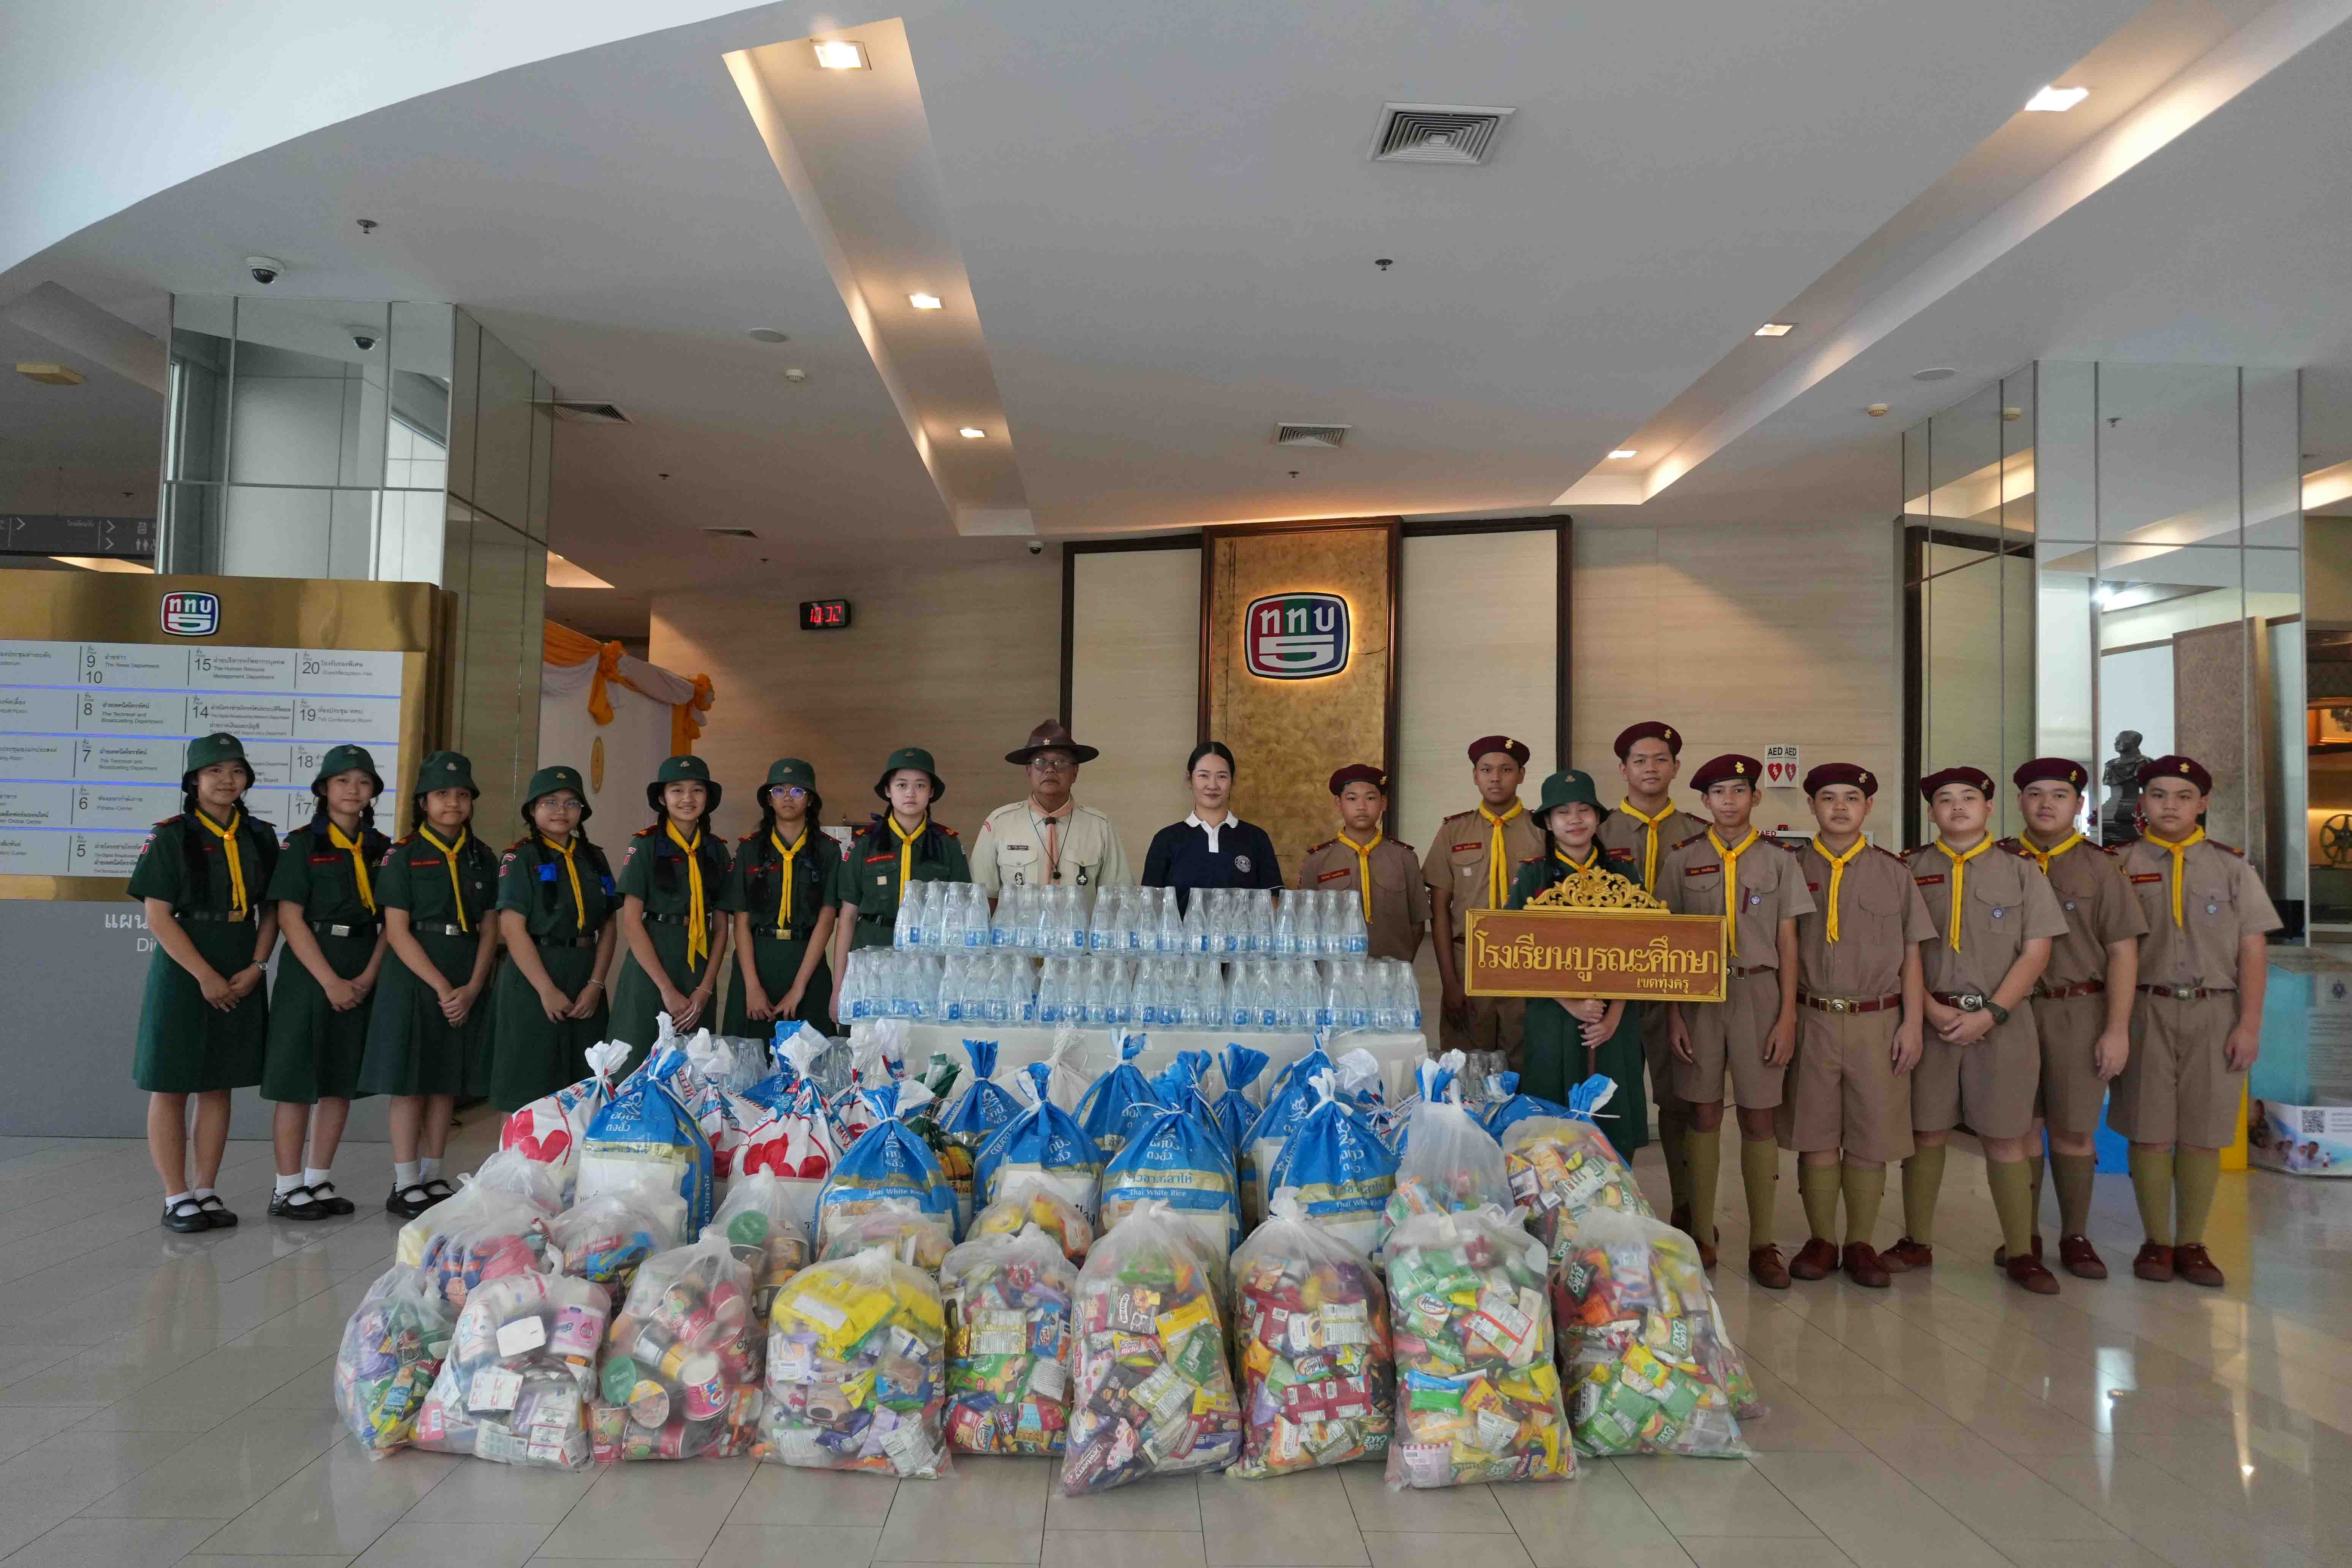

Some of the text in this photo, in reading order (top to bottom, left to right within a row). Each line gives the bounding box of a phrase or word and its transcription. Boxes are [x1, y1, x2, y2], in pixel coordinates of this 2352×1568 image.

[87, 655, 95, 668] 9
[194, 658, 211, 671] 15
[302, 661, 320, 674] 20
[85, 671, 103, 684] 10
[83, 703, 92, 716] 8
[192, 706, 209, 719] 14
[300, 709, 316, 721] 19
[82, 749, 92, 762] 7
[1768, 747, 1797, 756] AED AED
[297, 755, 313, 768] 18
[79, 797, 88, 810] 6
[295, 802, 312, 815] 17
[76, 844, 86, 857] 5
[1474, 931, 1719, 982] โรงเรียนบูรณะศึกษา
[1636, 974, 1689, 994] เขตทุ่งครุ
[1673, 1320, 1681, 1348] CAKE
[1075, 1443, 1104, 1479] Dewberry
